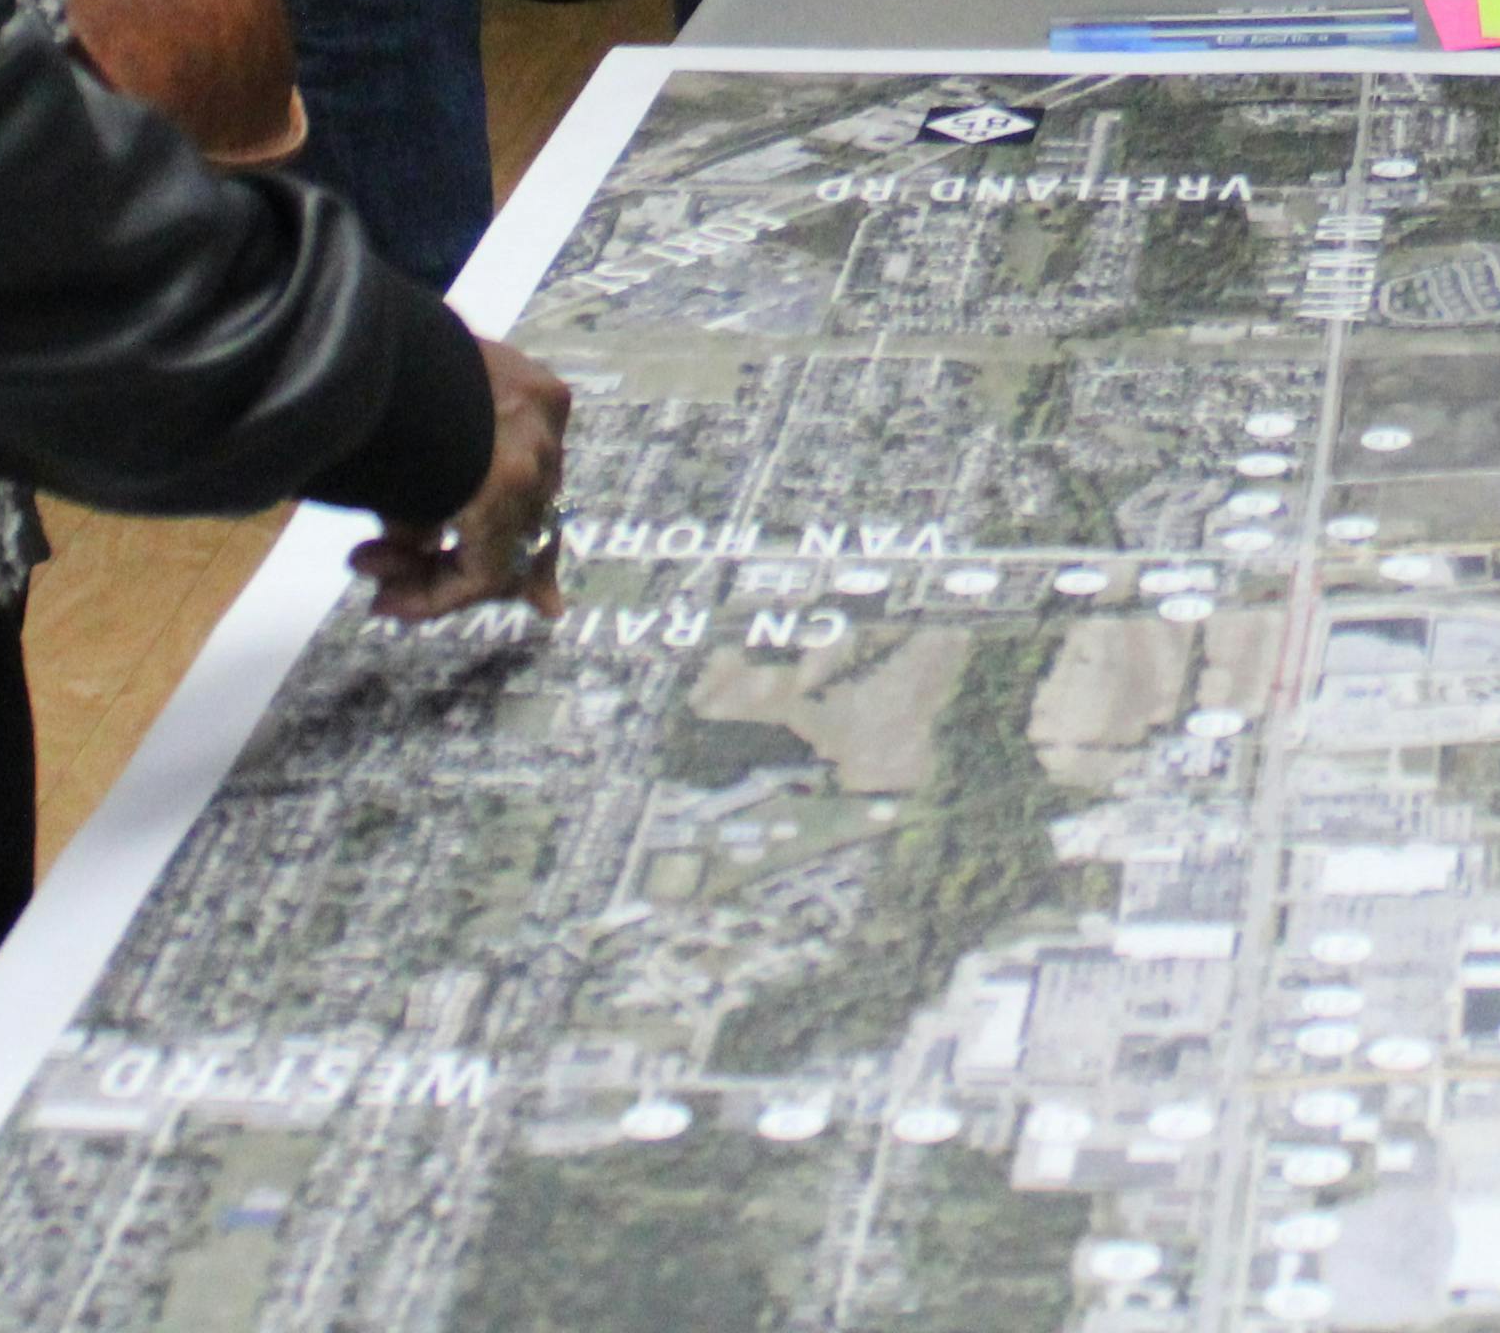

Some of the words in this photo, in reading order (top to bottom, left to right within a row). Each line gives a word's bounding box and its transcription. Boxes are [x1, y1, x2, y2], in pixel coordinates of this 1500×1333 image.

[949, 116, 1012, 130] 85
[815, 177, 900, 203] RD
[929, 175, 1253, 203] VREELAND
[1313, 215, 1385, 241] RD
[1297, 252, 1377, 321] ALLEN
[799, 521, 946, 559] VAN
[746, 609, 848, 648] CN
[97, 1047, 220, 1098] RD
[255, 1055, 493, 1107] WEST
